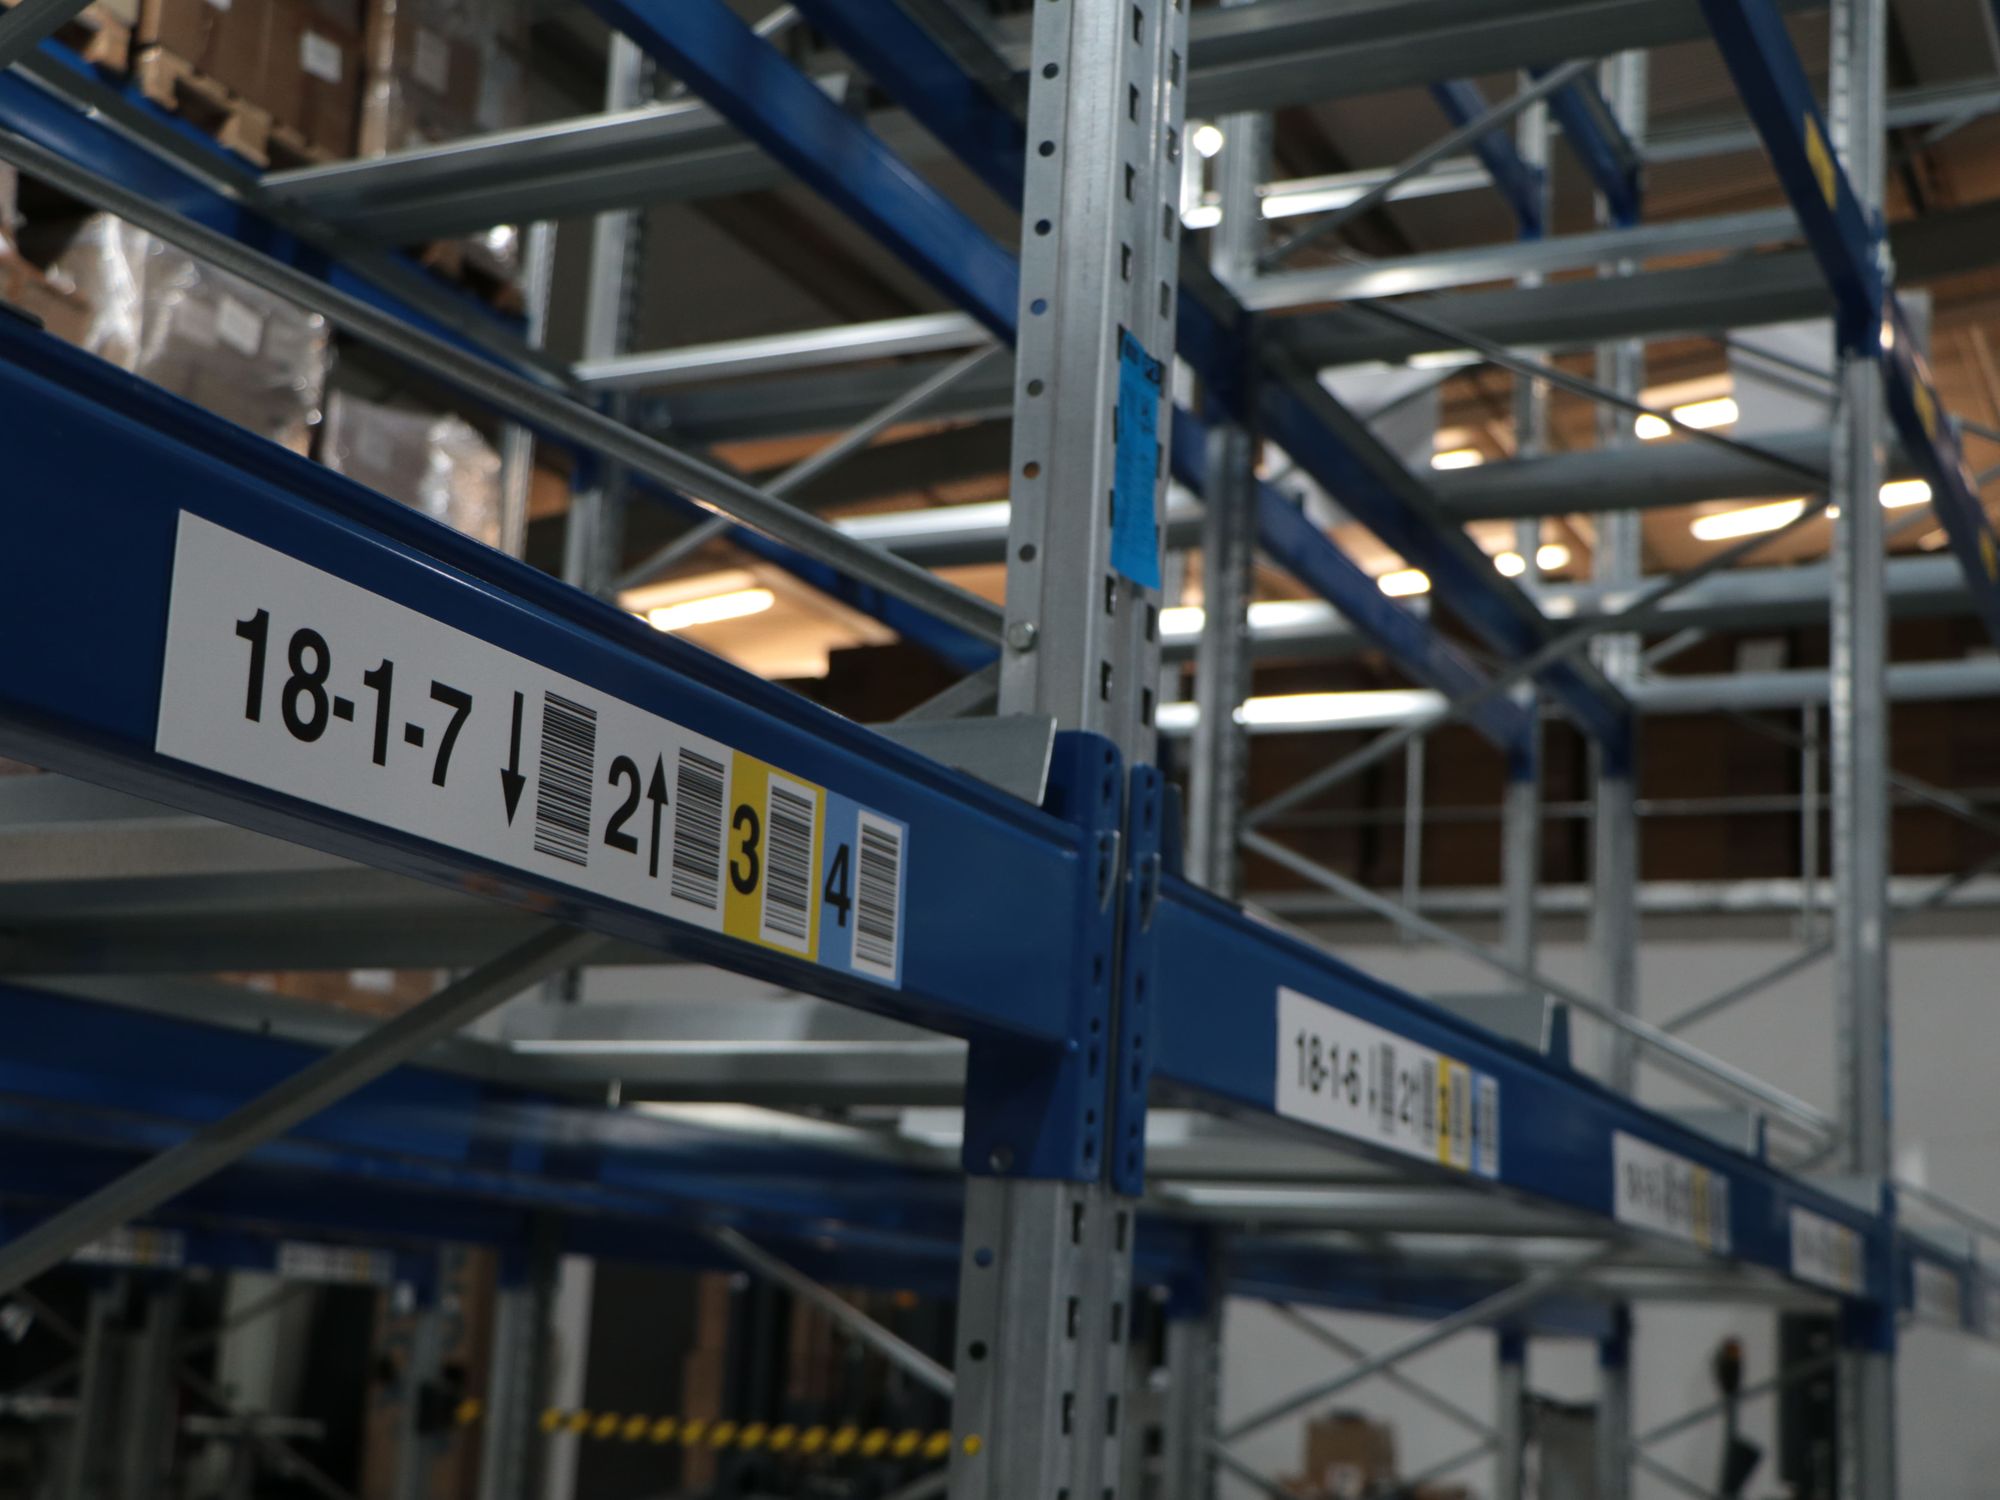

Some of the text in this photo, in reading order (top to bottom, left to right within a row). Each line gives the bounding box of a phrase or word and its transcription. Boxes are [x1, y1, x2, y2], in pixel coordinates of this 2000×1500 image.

[235, 608, 851, 927] 18-1-7 2 3 4
[1295, 1029, 1361, 1106] 18-1-6
